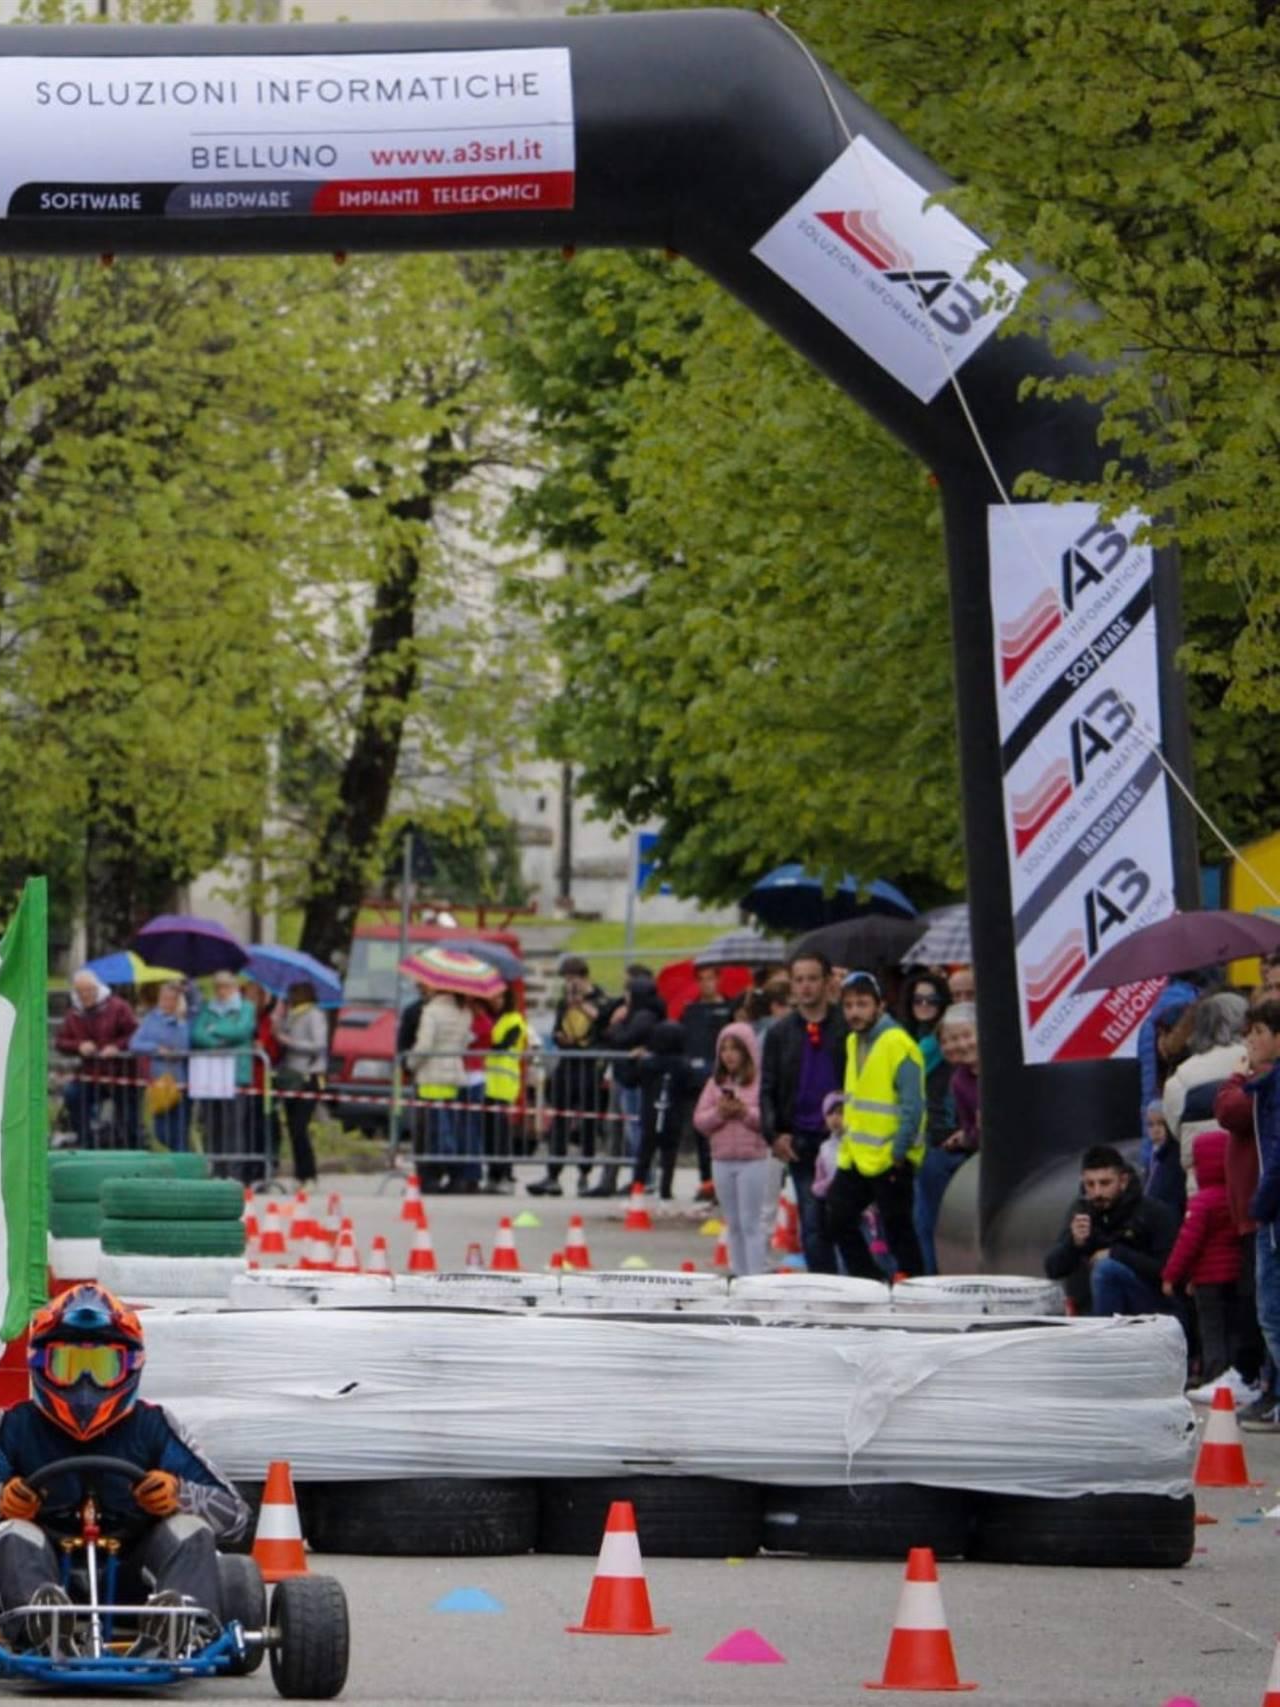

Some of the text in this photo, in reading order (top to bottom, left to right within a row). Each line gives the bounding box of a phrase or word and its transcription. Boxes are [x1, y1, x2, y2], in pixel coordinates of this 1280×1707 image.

[36, 73, 540, 106] SOLUZIONI INFORMATICHE
[191, 139, 543, 170] BELLUNO www.a3srl.it
[40, 184, 540, 210] SOFTWARE HARDWARE IMPIANTI TELEFONICI
[797, 218, 862, 281] SOLUZIONI
[884, 270, 982, 336] A3
[1061, 520, 1130, 617] A3
[1010, 638, 1070, 703] SOLUZIONI
[1071, 688, 1136, 788] A3
[1024, 809, 1081, 875] SOLUZIONI
[1077, 781, 1142, 857] HARDWARE
[1084, 858, 1151, 960] A3
[1035, 994, 1082, 1048] SOLUZIO
[1100, 975, 1168, 1043] TELEFONIC
